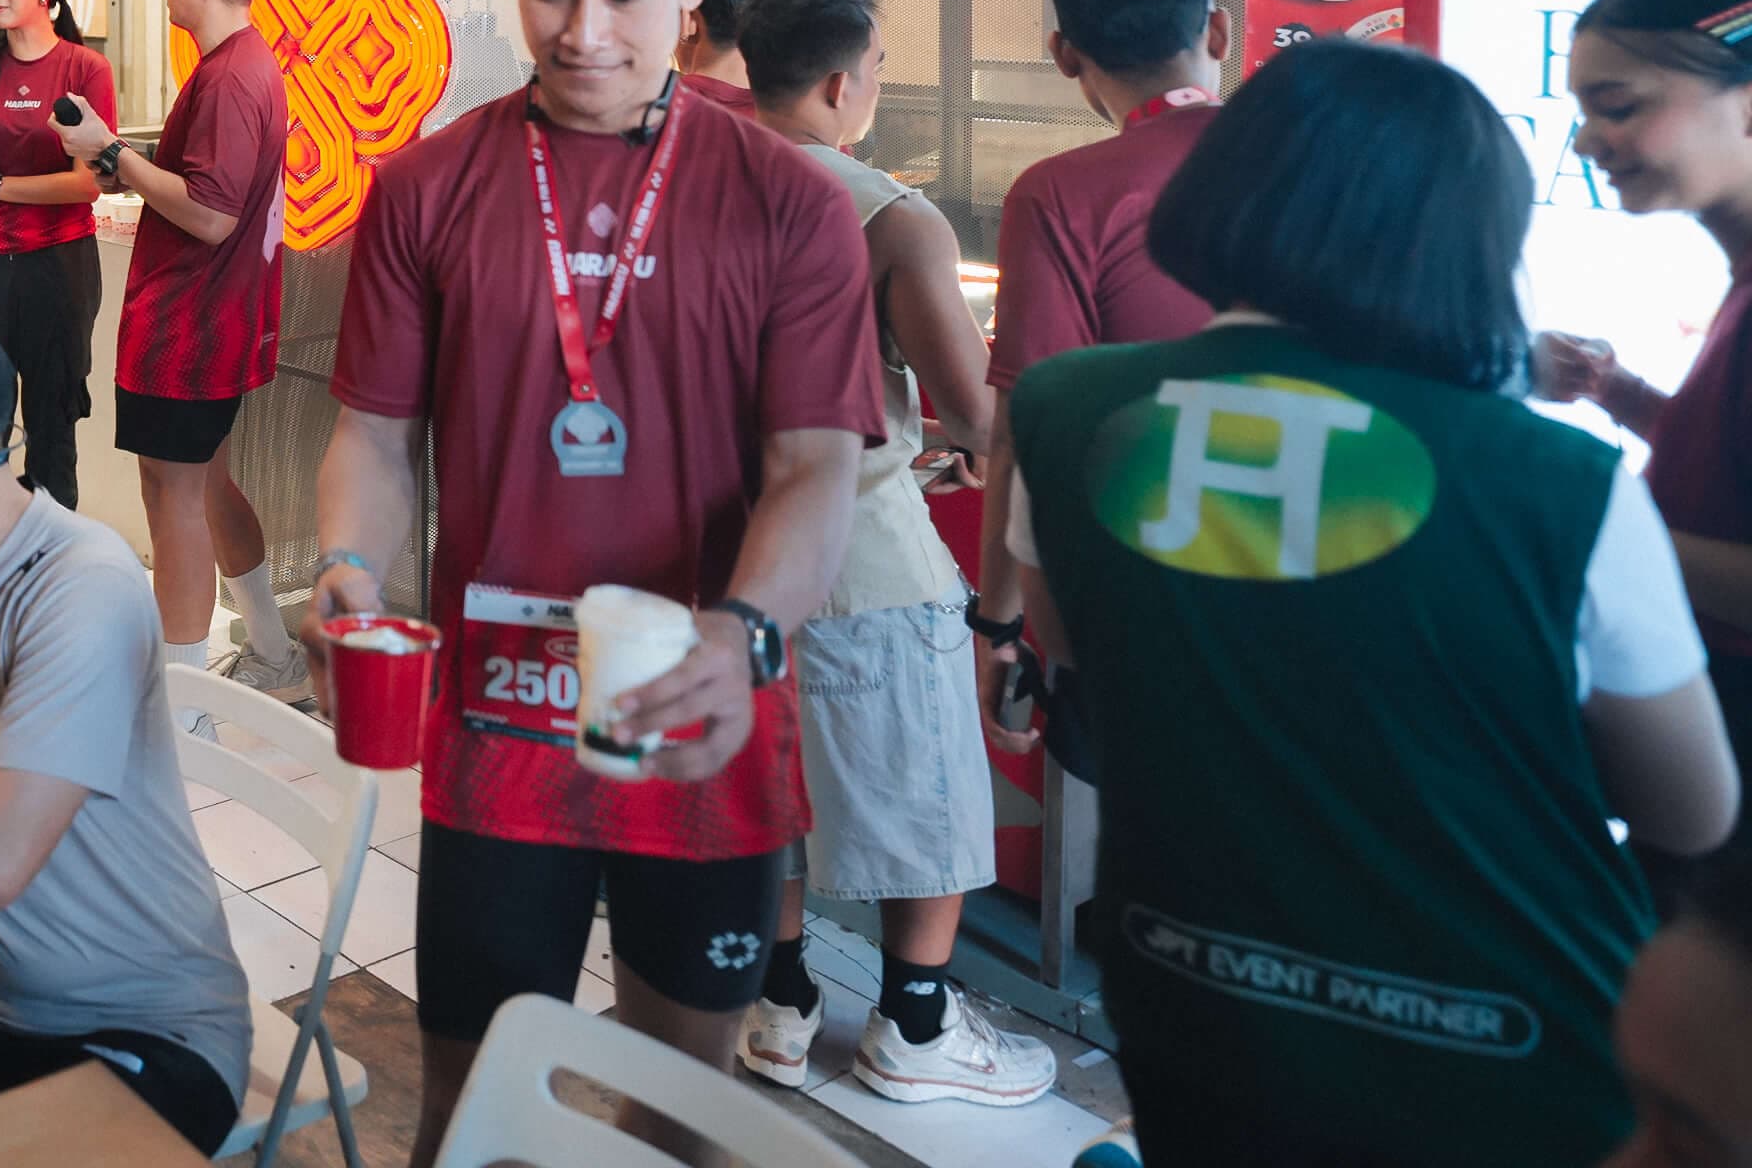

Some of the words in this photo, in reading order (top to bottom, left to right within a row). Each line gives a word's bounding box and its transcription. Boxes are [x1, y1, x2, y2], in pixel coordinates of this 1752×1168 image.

[4, 99, 42, 109] HARAKU
[566, 251, 656, 279] ARAU
[1206, 944, 1319, 998] EVENT
[1328, 976, 1503, 1040] PARTNER
